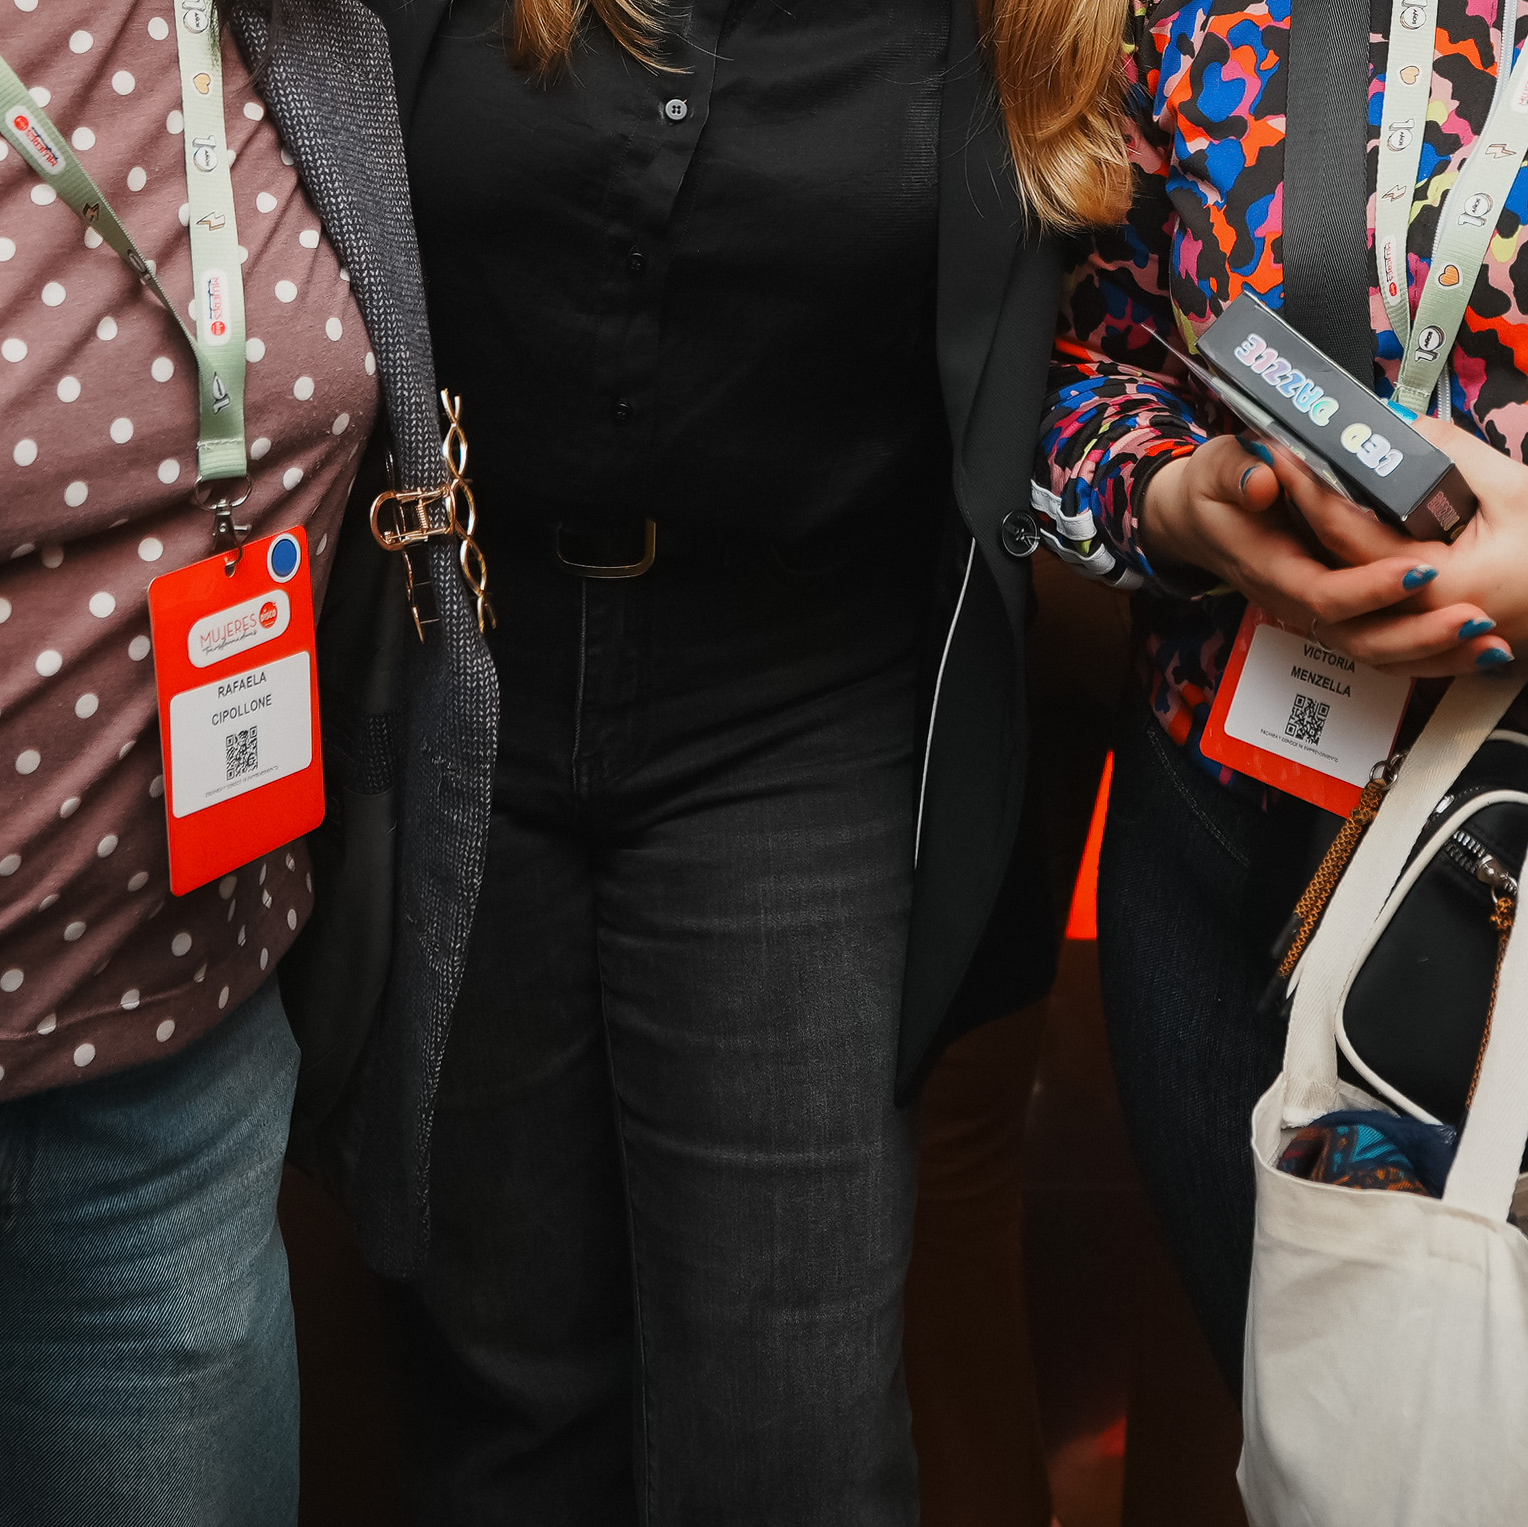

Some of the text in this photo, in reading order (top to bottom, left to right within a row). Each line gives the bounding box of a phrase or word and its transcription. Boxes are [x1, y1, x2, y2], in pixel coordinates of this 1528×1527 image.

[1233, 332, 1340, 427] DAZZLE
[200, 613, 258, 648] MUJERES
[1303, 644, 1356, 674] VICTORIA
[217, 672, 267, 699] RAFAELA
[1291, 665, 1351, 698] MENZELLA
[211, 694, 273, 726] CIPOLLONE
